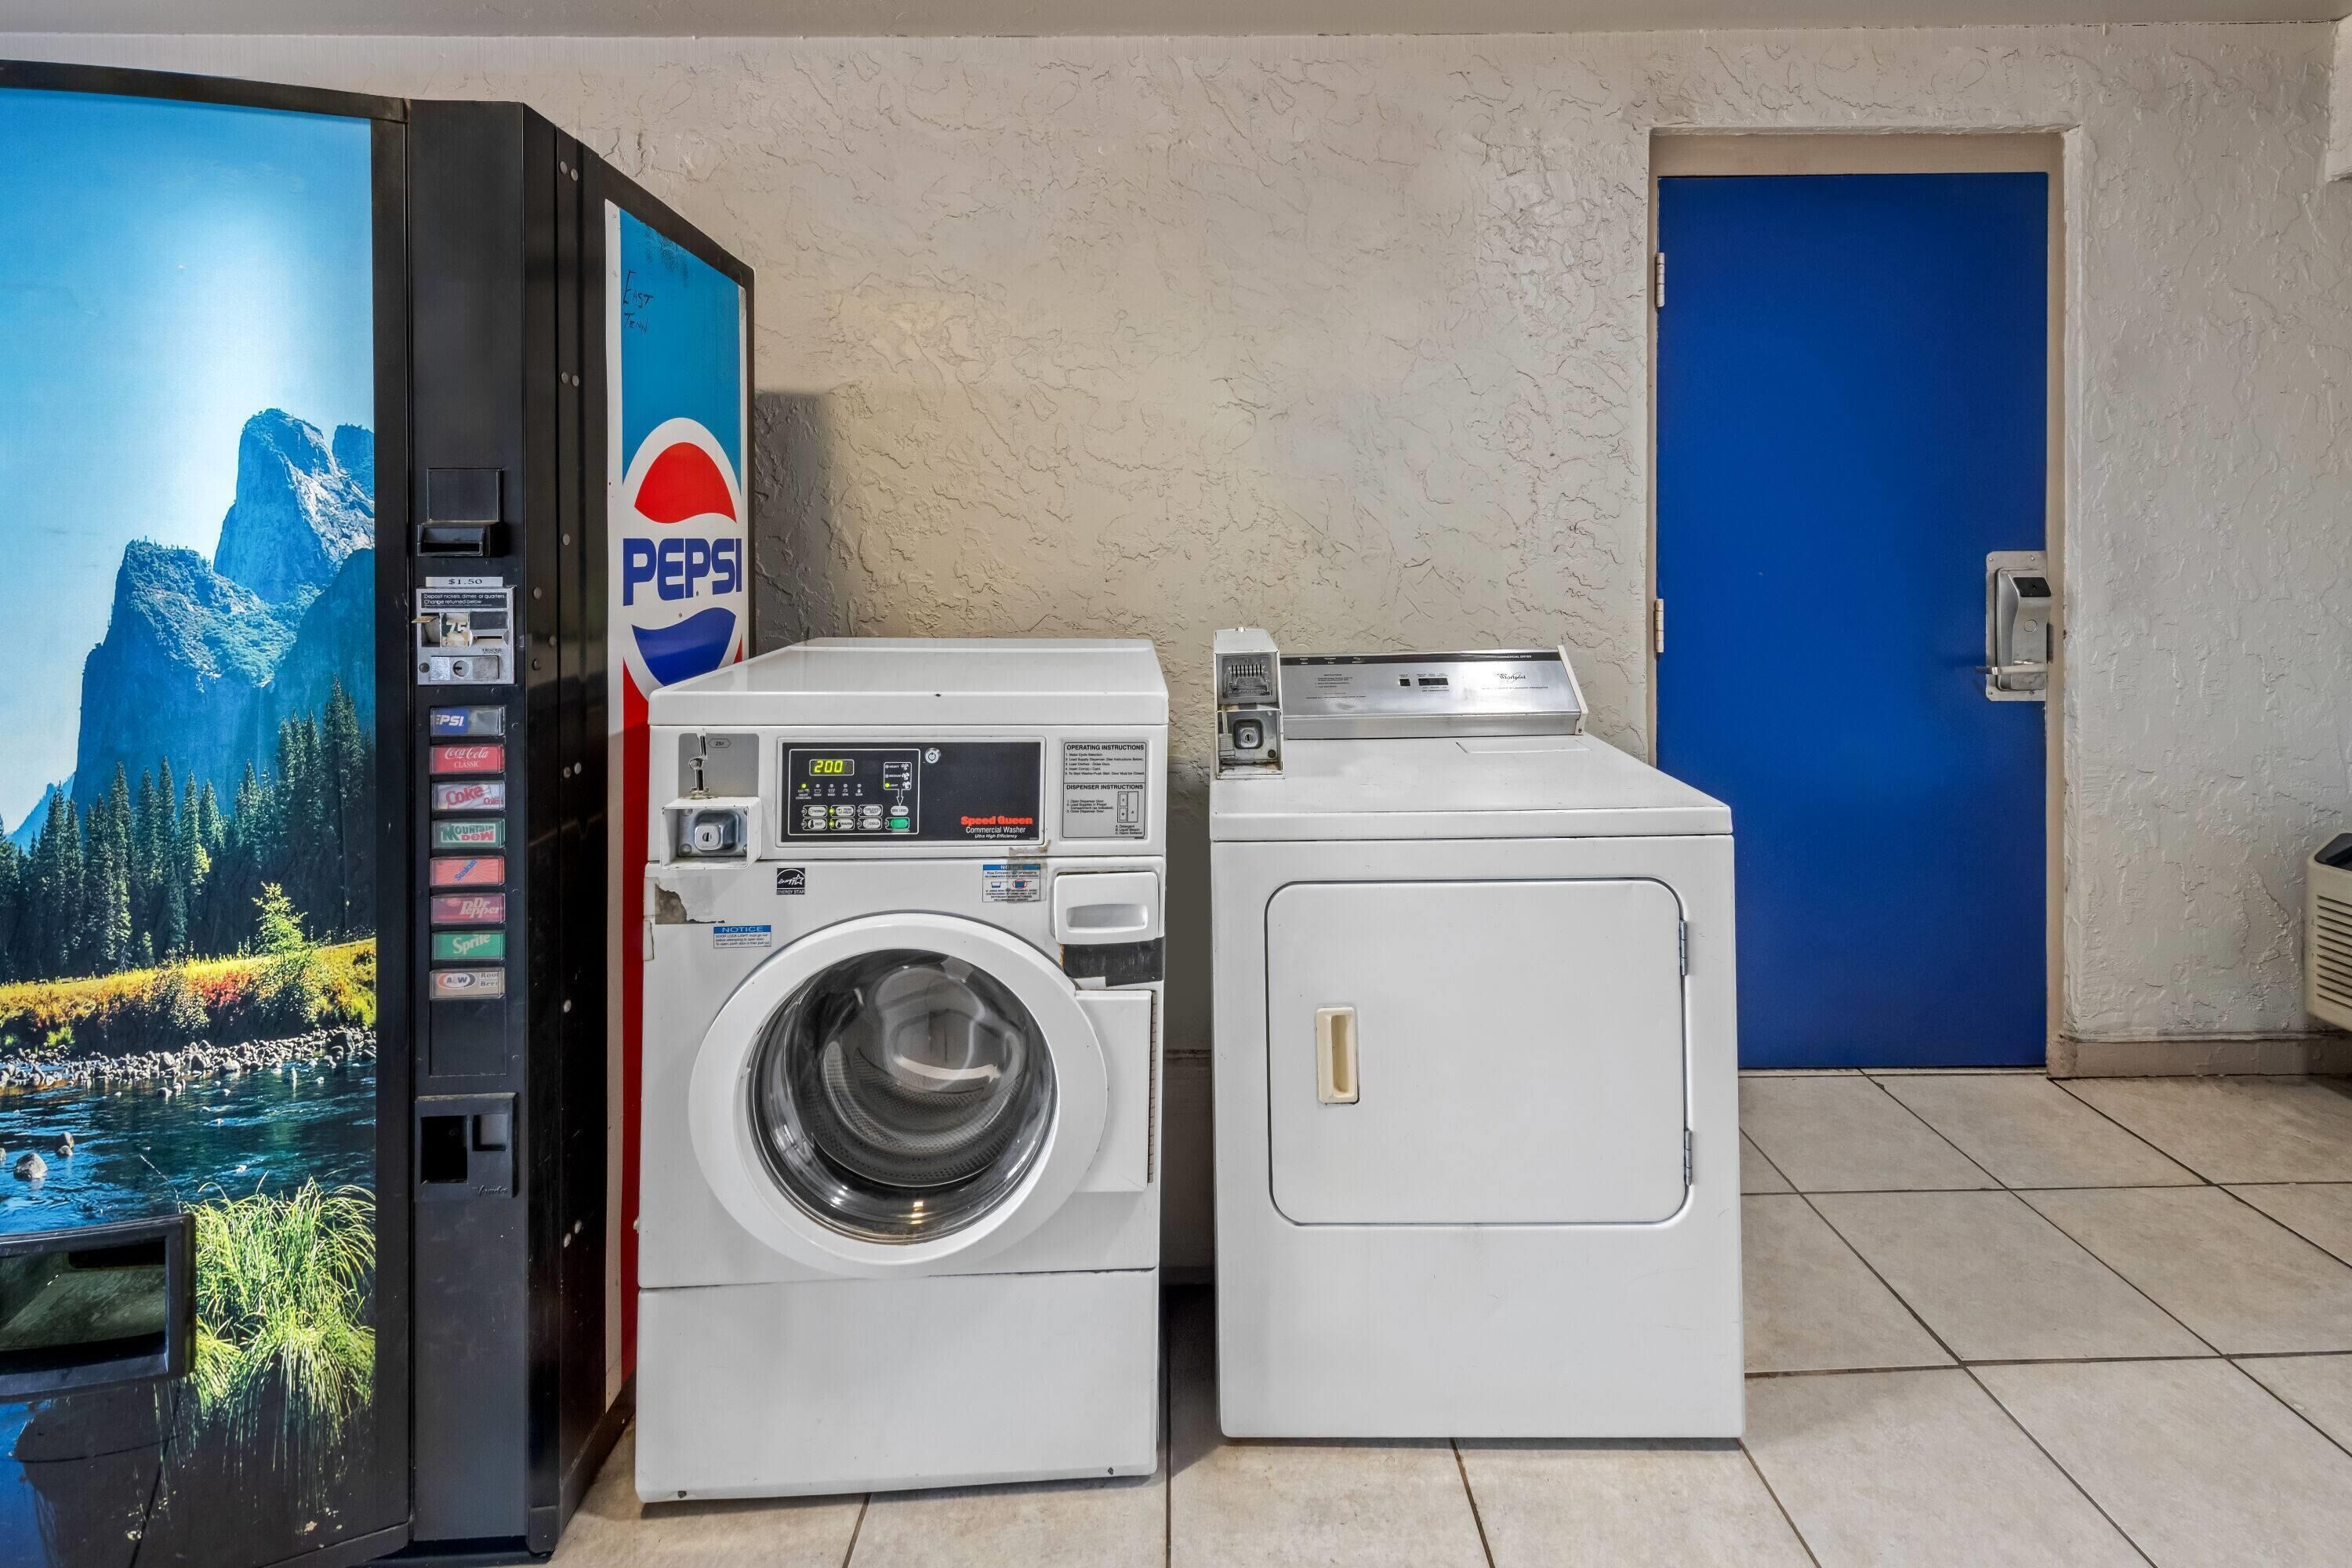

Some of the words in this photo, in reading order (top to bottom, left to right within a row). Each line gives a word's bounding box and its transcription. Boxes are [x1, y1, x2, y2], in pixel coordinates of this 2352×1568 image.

[623, 270, 654, 308] EAST
[624, 313, 648, 335] TENN
[623, 539, 742, 606] PEPSI
[814, 760, 843, 773] 200
[446, 786, 484, 806] Coke
[960, 815, 996, 826] Speed
[997, 815, 1033, 825] Queen
[459, 901, 500, 918] Pepper
[474, 897, 490, 907] Dr
[452, 934, 490, 954] Sprite
